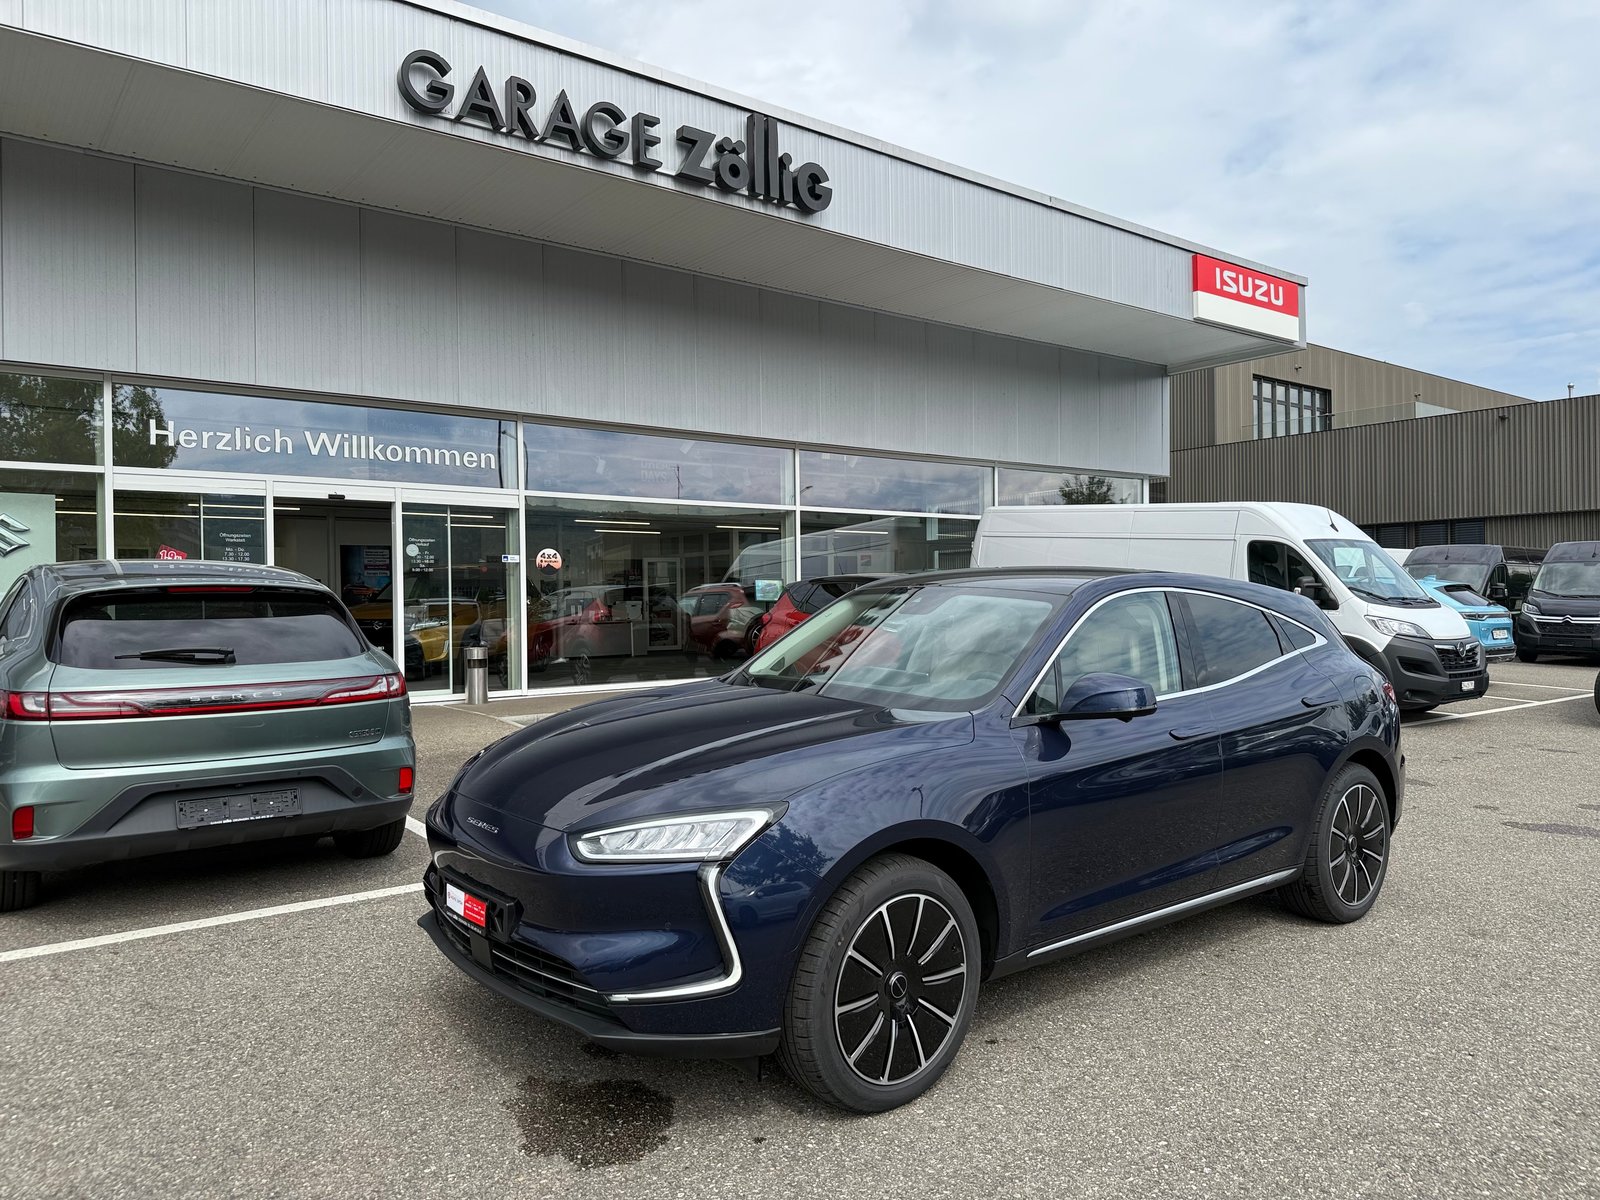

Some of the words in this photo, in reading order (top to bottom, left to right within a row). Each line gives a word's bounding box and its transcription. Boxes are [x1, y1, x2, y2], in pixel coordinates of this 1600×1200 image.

[397, 49, 663, 171] GARAGE
[1215, 267, 1284, 306] ISUZU
[149, 418, 293, 455] Herzlich
[303, 430, 497, 470] Willkommen
[540, 552, 558, 560] 4x4
